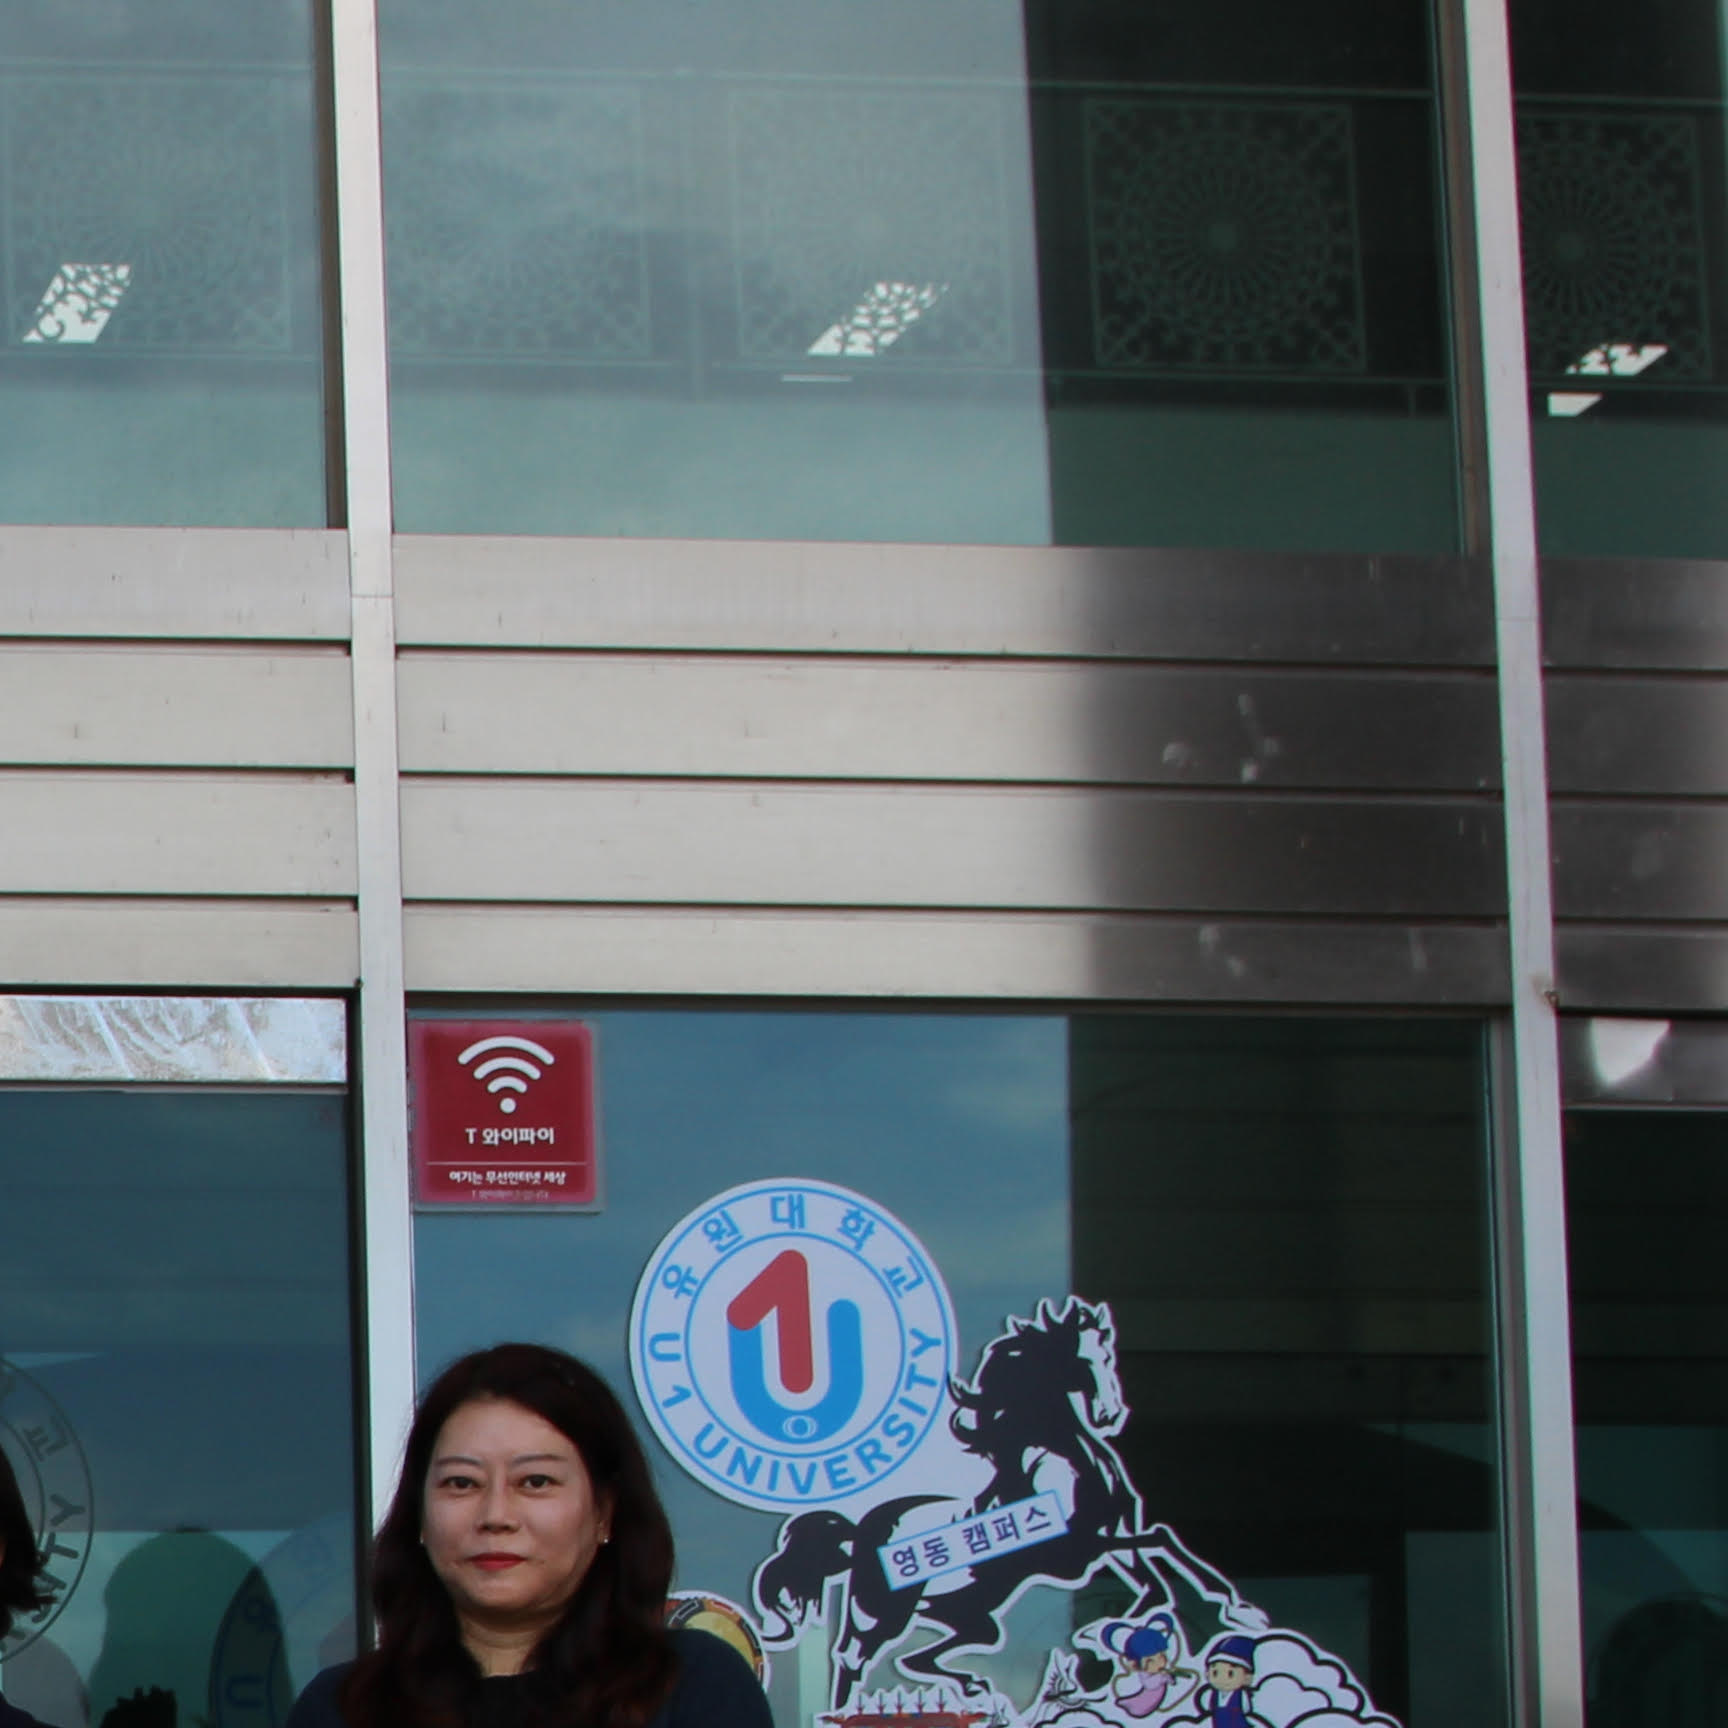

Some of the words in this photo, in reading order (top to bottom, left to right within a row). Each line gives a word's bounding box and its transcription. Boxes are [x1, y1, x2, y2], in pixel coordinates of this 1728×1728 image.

[465, 1128, 477, 1144] T
[482, 1127, 555, 1145] 와이파이
[661, 1194, 925, 1300] 유원대학교
[693, 1327, 942, 1495] UNIVERSITY
[892, 1535, 950, 1578] 영동
[962, 1505, 1052, 1556] 캠퍼스
